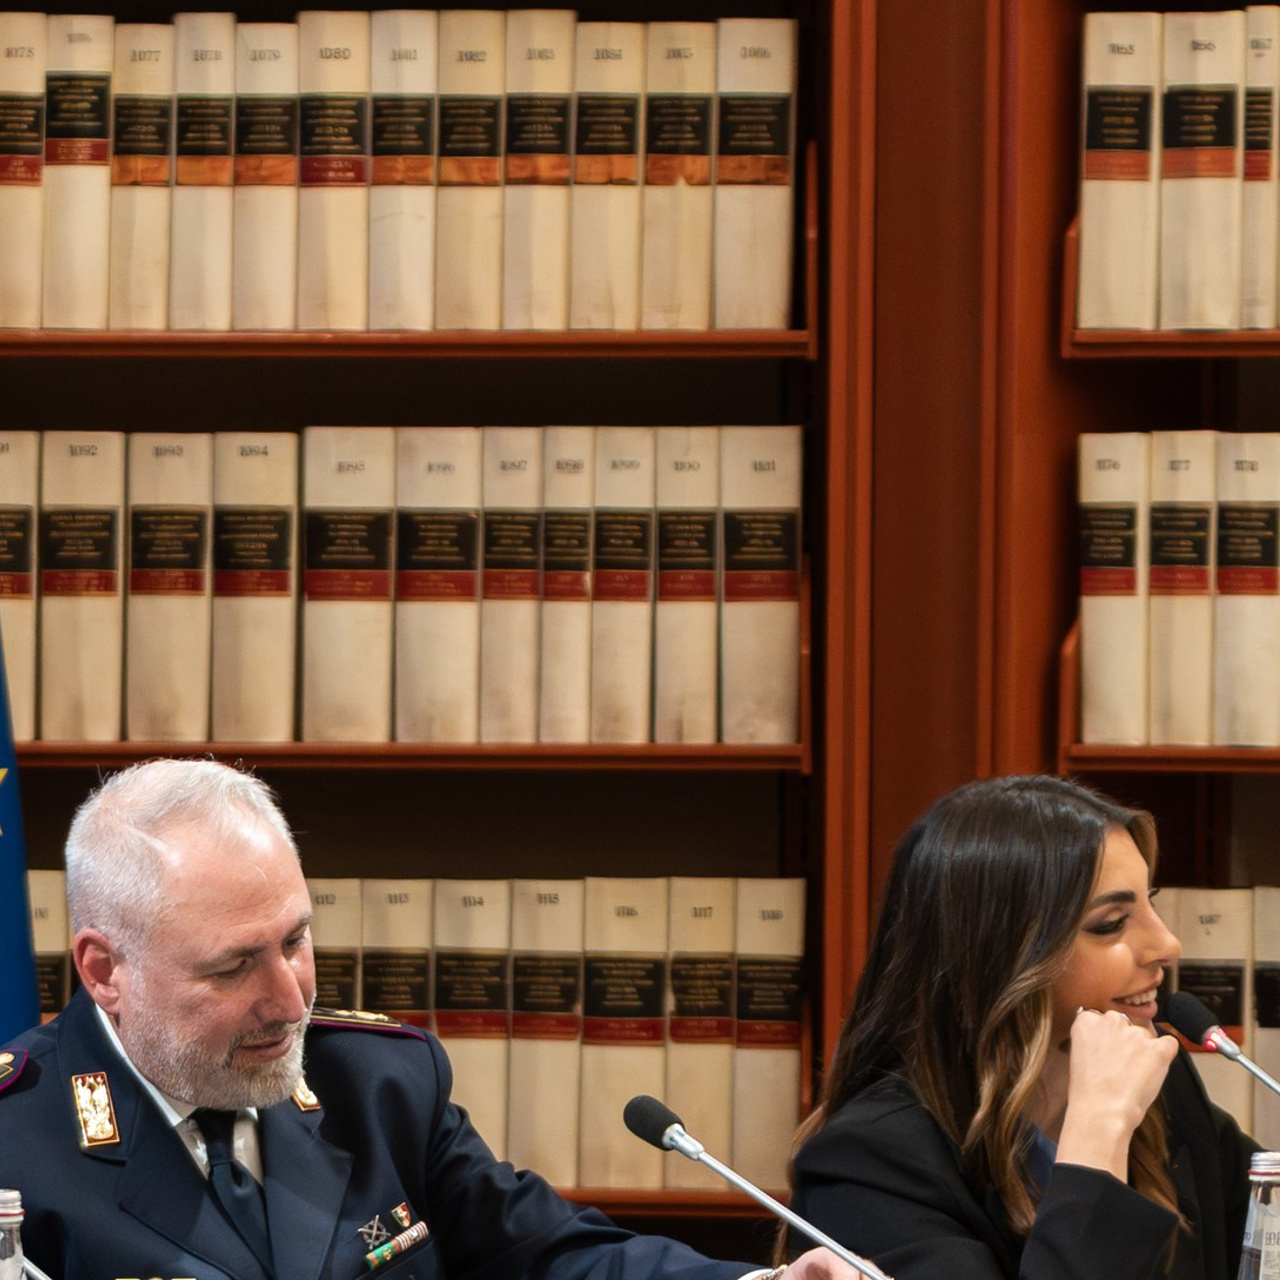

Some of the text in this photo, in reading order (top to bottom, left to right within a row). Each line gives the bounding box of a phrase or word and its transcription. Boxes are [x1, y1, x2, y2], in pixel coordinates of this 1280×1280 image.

[131, 50, 160, 61] 1077
[319, 48, 350, 59] 1080
[69, 445, 98, 456] 1092
